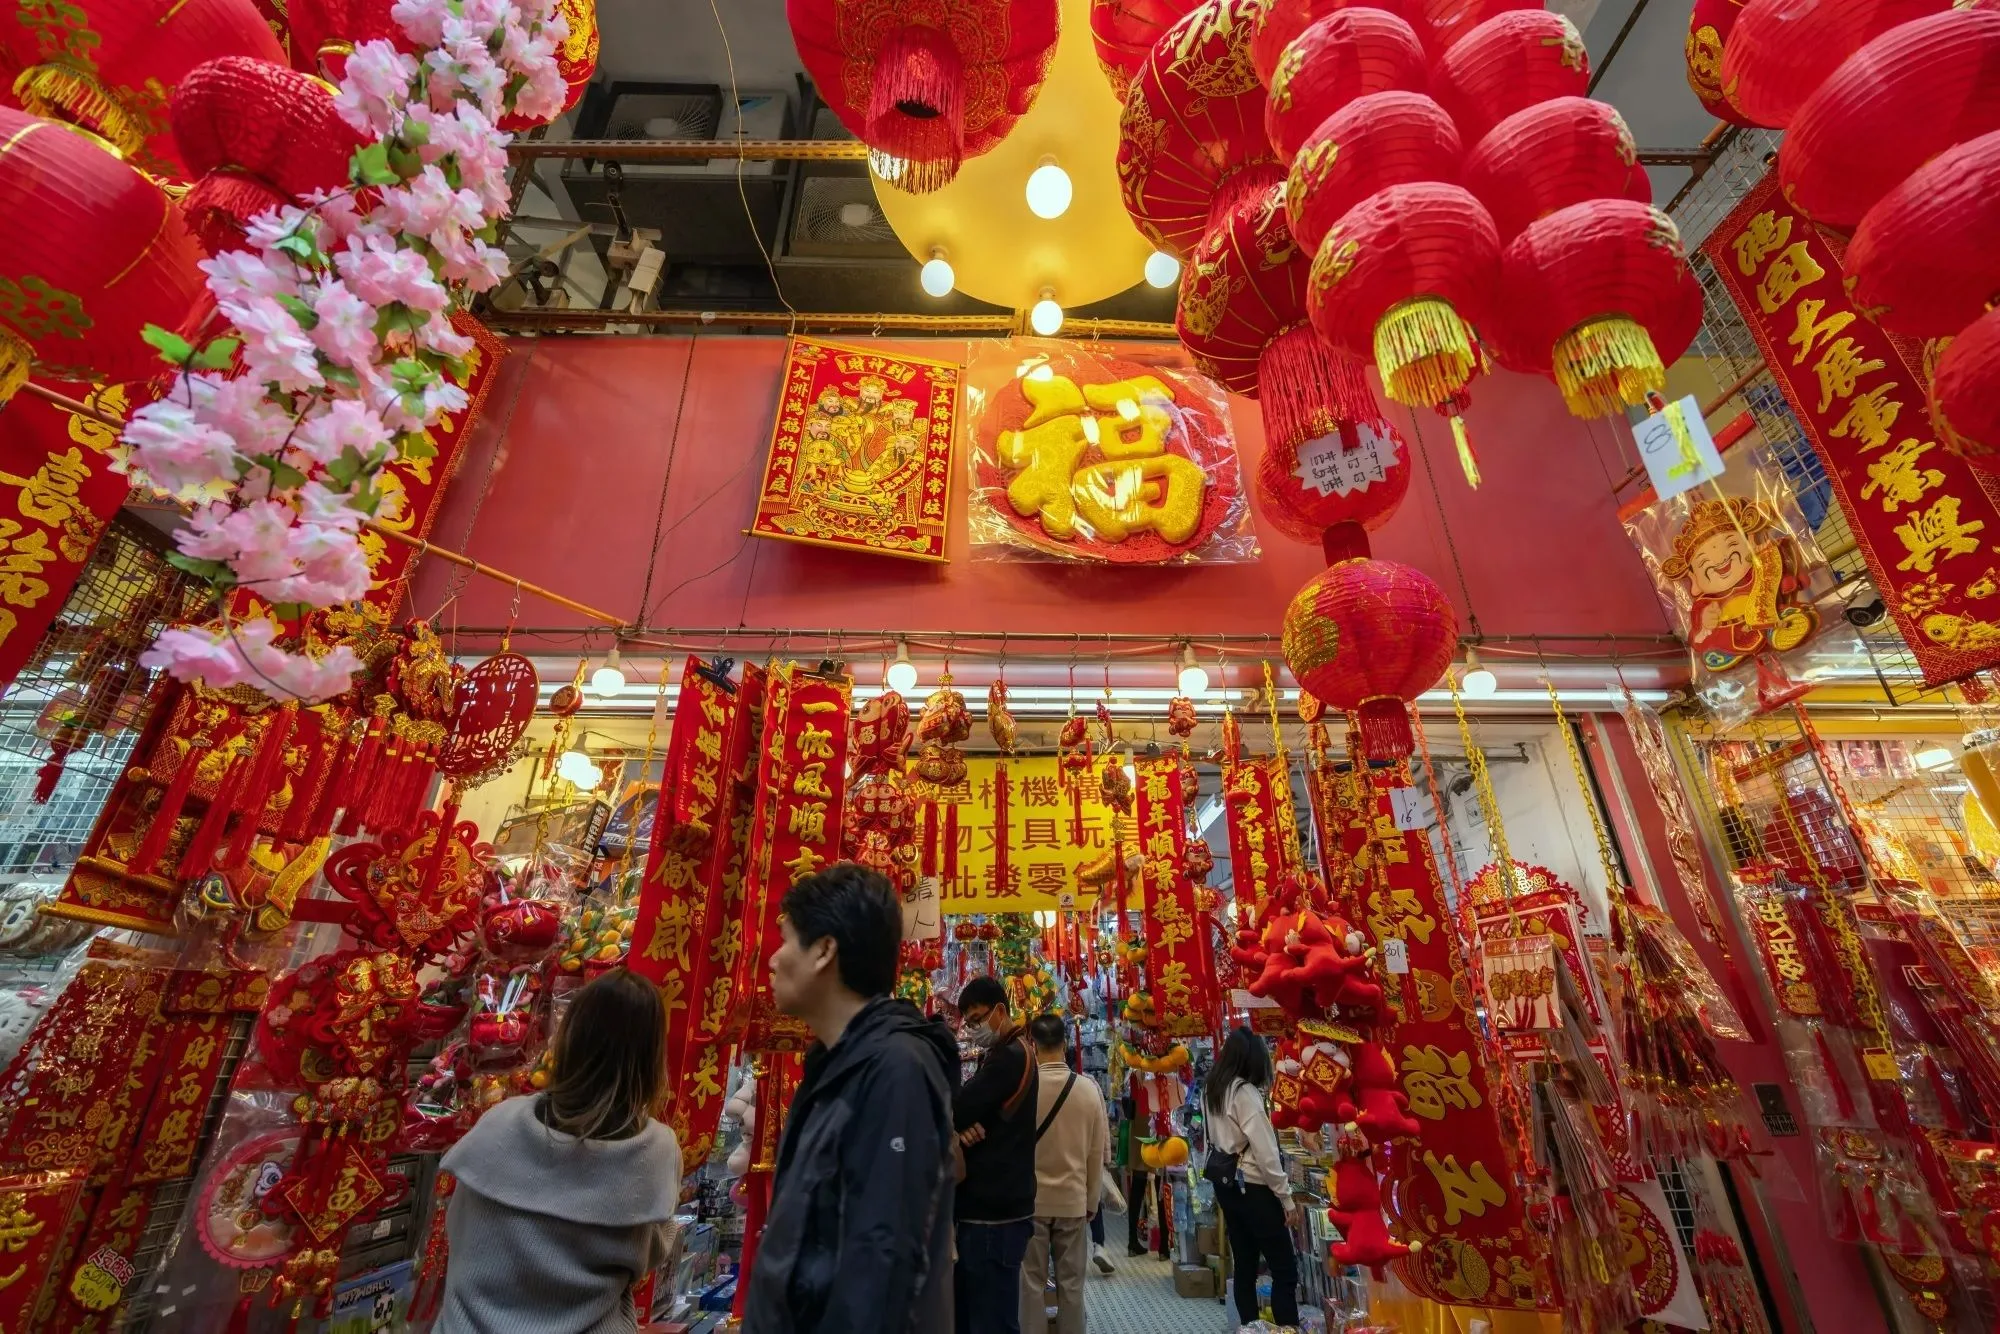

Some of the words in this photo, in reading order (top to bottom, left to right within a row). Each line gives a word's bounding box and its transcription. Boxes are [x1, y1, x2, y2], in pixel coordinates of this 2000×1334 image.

[848, 356, 905, 381] 財神到
[923, 390, 951, 515] 五路財神家常駐
[996, 374, 1206, 546] 福
